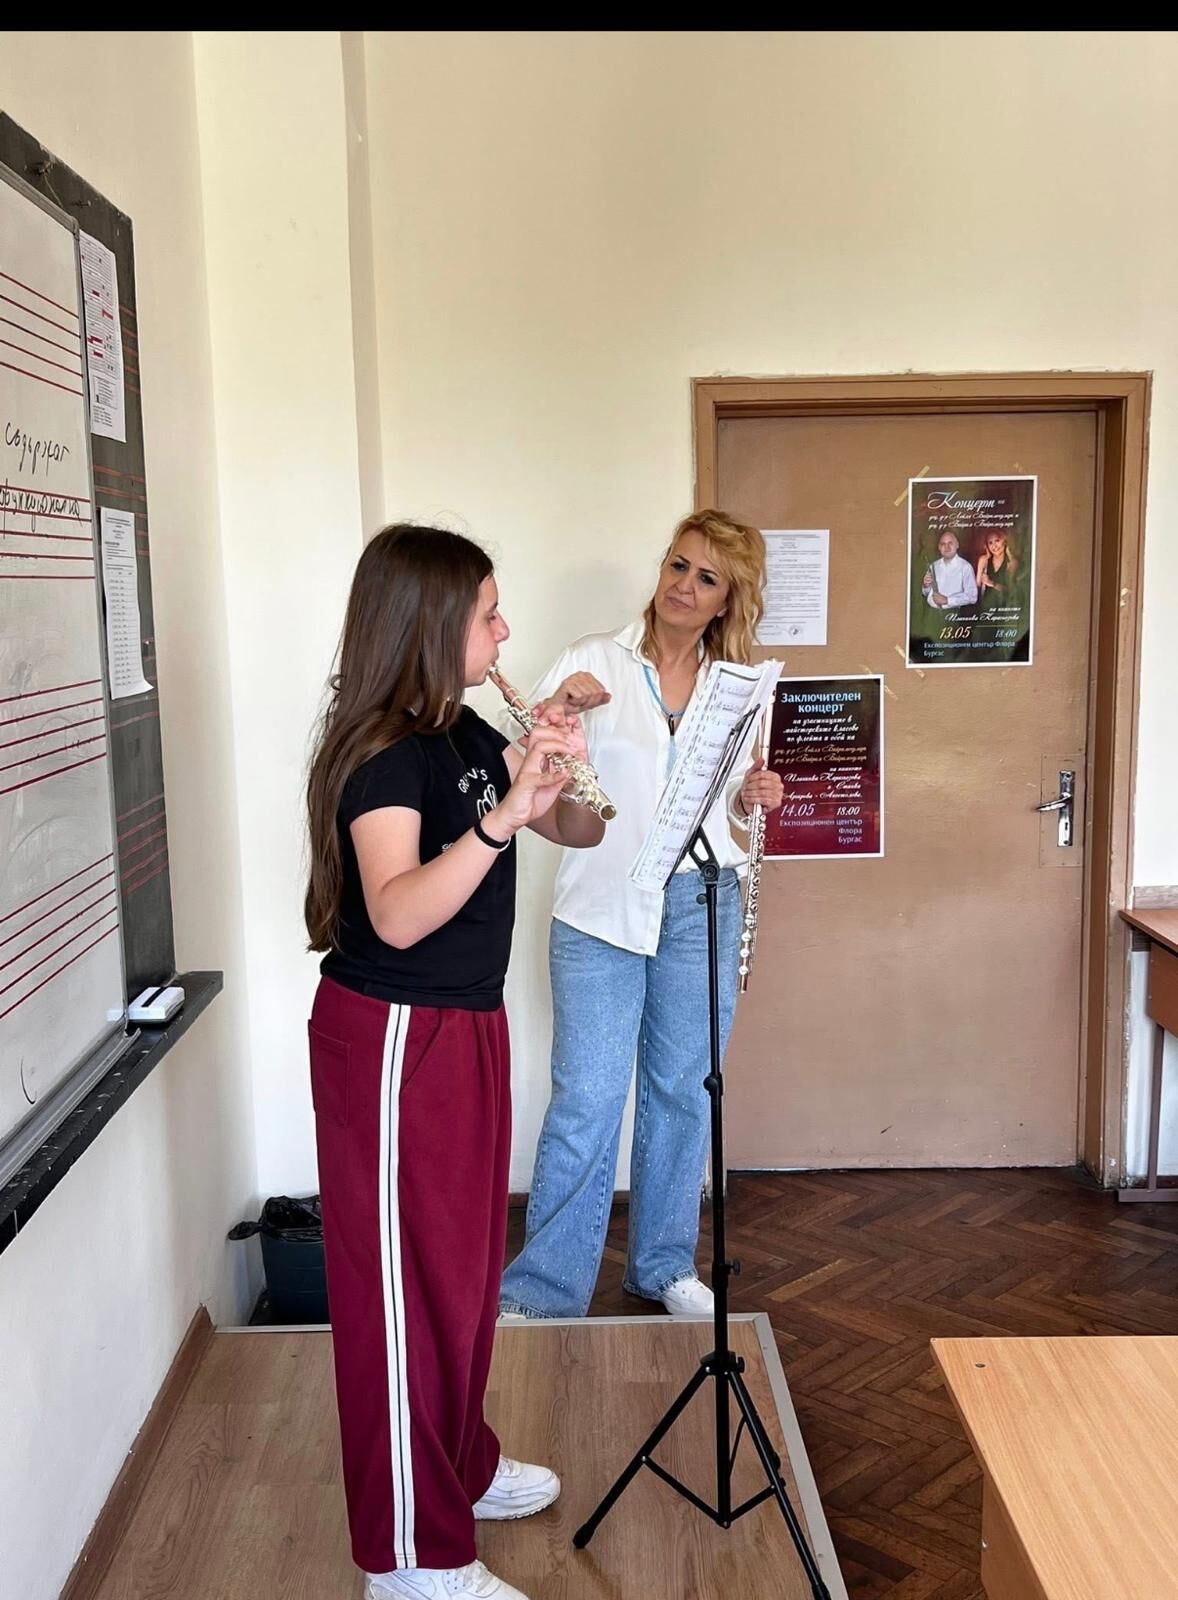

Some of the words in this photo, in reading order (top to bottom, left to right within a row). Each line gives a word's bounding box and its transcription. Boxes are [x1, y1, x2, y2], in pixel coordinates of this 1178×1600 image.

[928, 490, 995, 512] Концерт
[940, 626, 972, 640] 13.05
[781, 692, 862, 703] Заключителен
[798, 704, 845, 715] концерт
[780, 803, 816, 818] 14.05
[836, 806, 861, 816] 18:00
[779, 819, 835, 828] Експозиционен
[836, 818, 862, 828] център
[838, 827, 862, 836] Флора
[838, 836, 862, 846] Бургас
